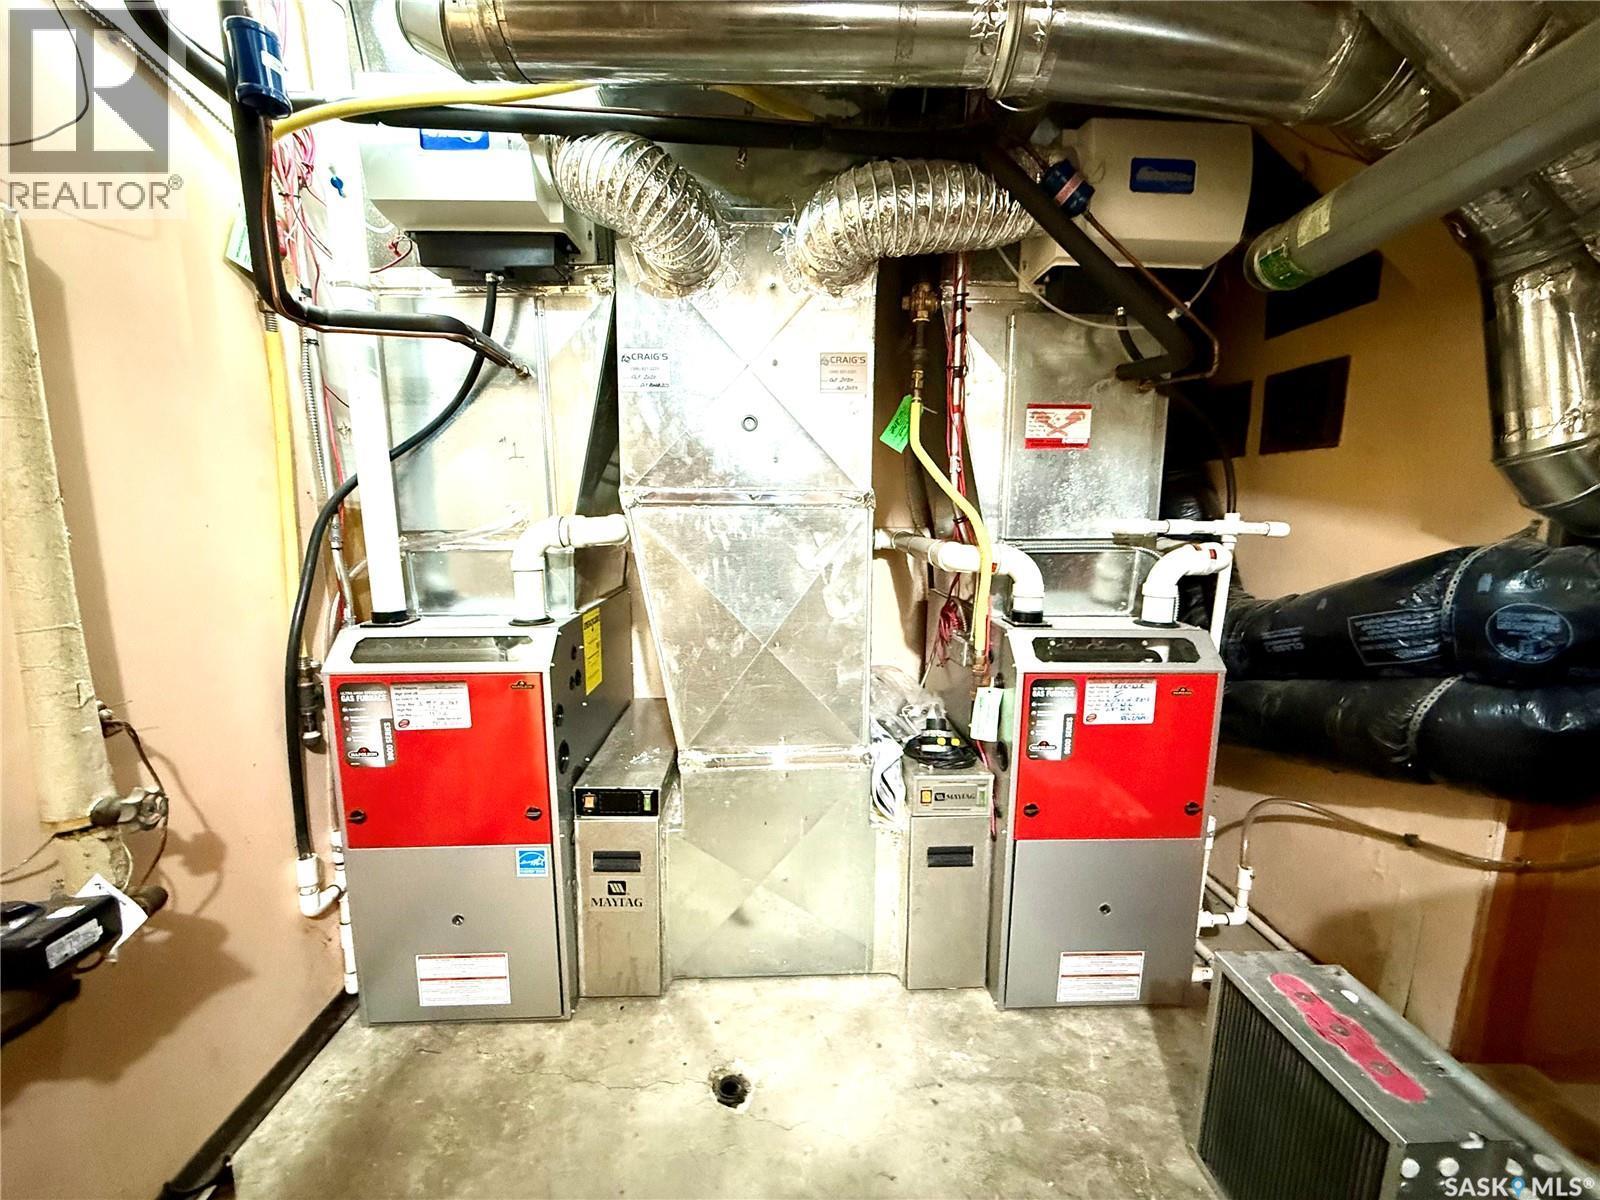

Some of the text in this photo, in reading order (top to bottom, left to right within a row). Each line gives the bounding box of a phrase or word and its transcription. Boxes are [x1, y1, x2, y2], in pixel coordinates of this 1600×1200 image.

[631, 352, 669, 361] CRAIG'S
[830, 356, 866, 364] CRAIG'S
[590, 897, 643, 907] MAYTAG
